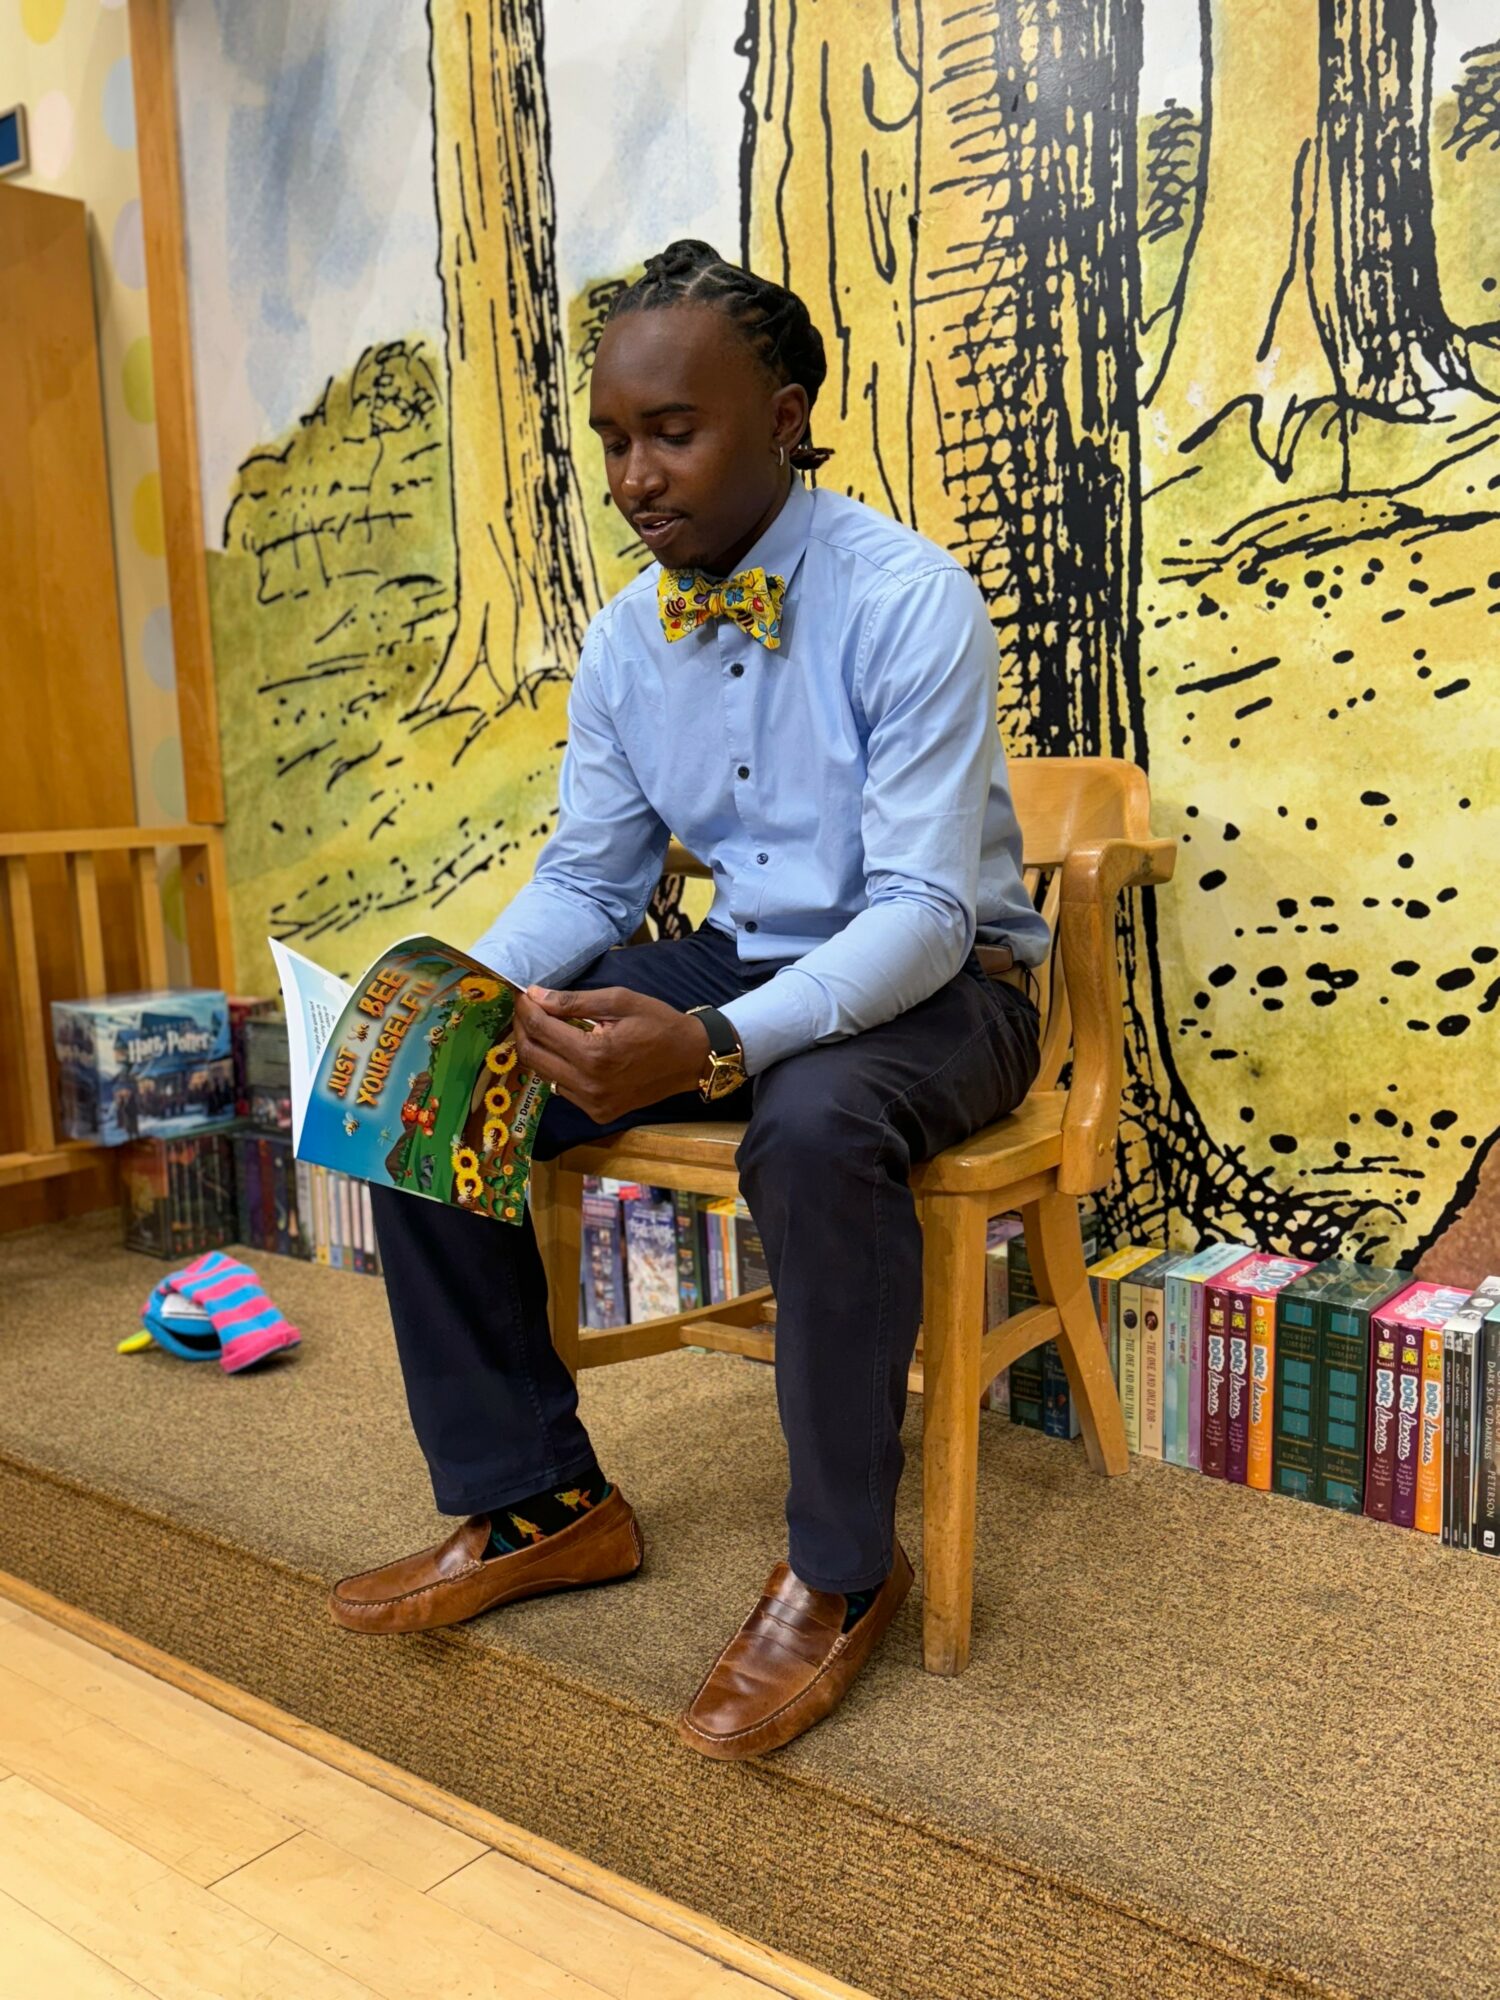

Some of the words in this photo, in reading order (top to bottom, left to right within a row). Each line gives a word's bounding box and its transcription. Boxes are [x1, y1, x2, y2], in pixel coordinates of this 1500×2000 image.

[127, 1035, 166, 1063] Harry
[167, 1031, 210, 1056] Potter
[328, 1044, 358, 1097] JUST
[358, 967, 411, 1018] BEE
[515, 1118, 525, 1133] By:
[520, 1086, 537, 1116] Derrin
[1213, 1297, 1220, 1307] 1
[1234, 1300, 1244, 1310] 2
[1126, 1338, 1135, 1352] THE
[1147, 1341, 1157, 1354] THE
[1383, 1329, 1390, 1339] 1
[1406, 1334, 1416, 1345] 2
[1125, 1354, 1135, 1367] ONE
[1146, 1357, 1156, 1371] ONE
[1208, 1335, 1225, 1372] DORK
[1230, 1337, 1247, 1375] DORK
[1252, 1345, 1268, 1382] DORK
[1125, 1369, 1135, 1383] AND
[1146, 1372, 1156, 1387] AND
[1376, 1369, 1393, 1408] DORK
[1487, 1360, 1496, 1385] DARK
[1125, 1384, 1135, 1401] ONLY
[1146, 1388, 1156, 1407] ONLY
[1208, 1370, 1224, 1416] diaries
[1229, 1373, 1246, 1419] diaries
[1251, 1381, 1267, 1425] diaries
[1400, 1374, 1418, 1413] DORK
[1424, 1380, 1441, 1419] DORK
[1486, 1387, 1495, 1402] SEA
[1125, 1403, 1134, 1420] IVAN
[1146, 1408, 1156, 1423] BOB
[1374, 1406, 1393, 1454] diaries
[1398, 1412, 1417, 1460] diaries
[1423, 1419, 1439, 1465] diaries
[1484, 1418, 1494, 1460] DARKNESS
[1486, 1470, 1496, 1518] PETERSON
